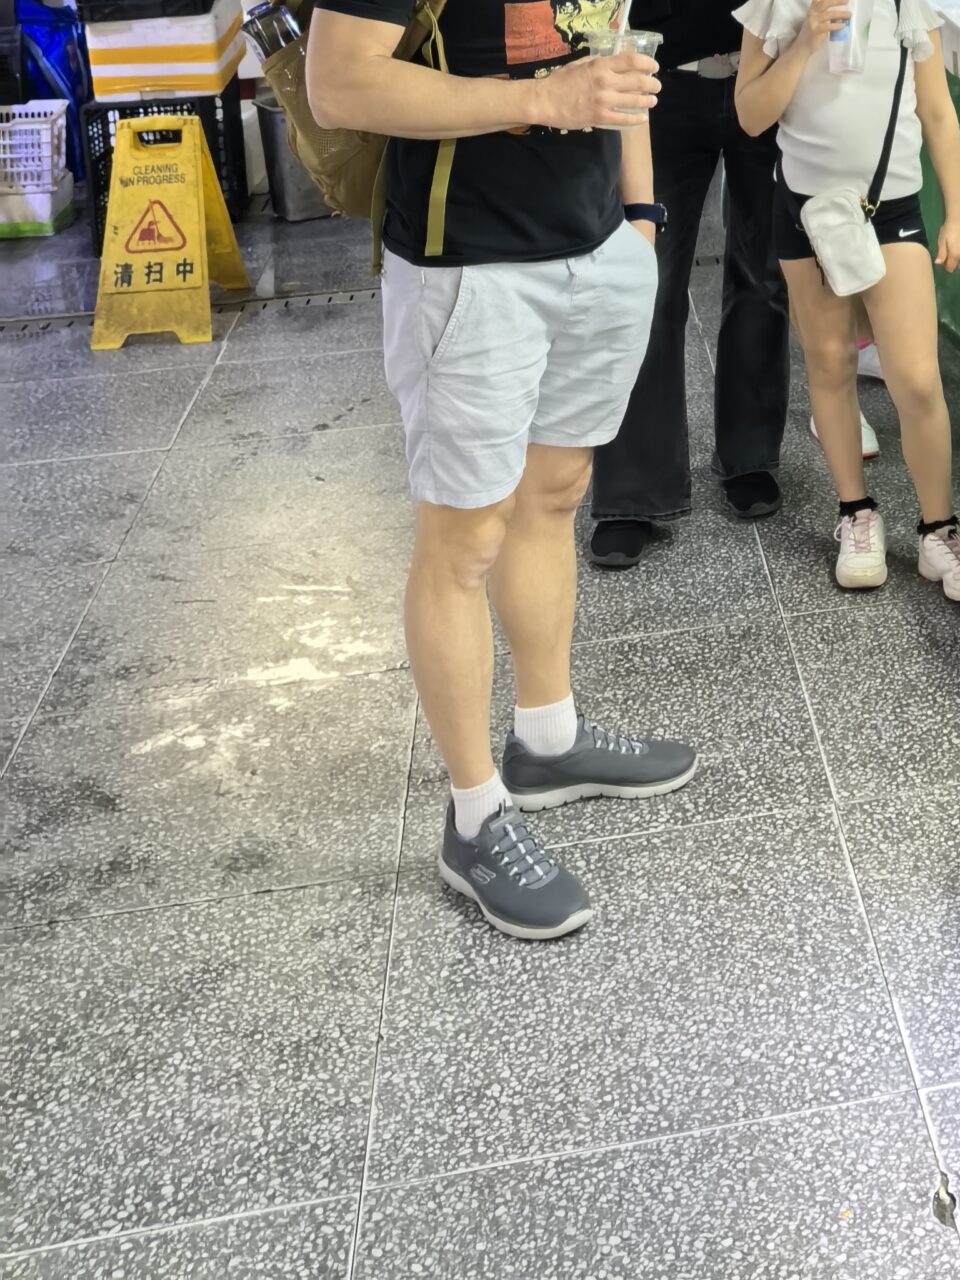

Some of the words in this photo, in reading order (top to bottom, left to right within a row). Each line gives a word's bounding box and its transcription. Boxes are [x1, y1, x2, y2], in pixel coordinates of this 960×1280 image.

[132, 163, 179, 176] CLEANING
[136, 173, 186, 185] PROGRESS
[114, 257, 194, 288] 清扫中
